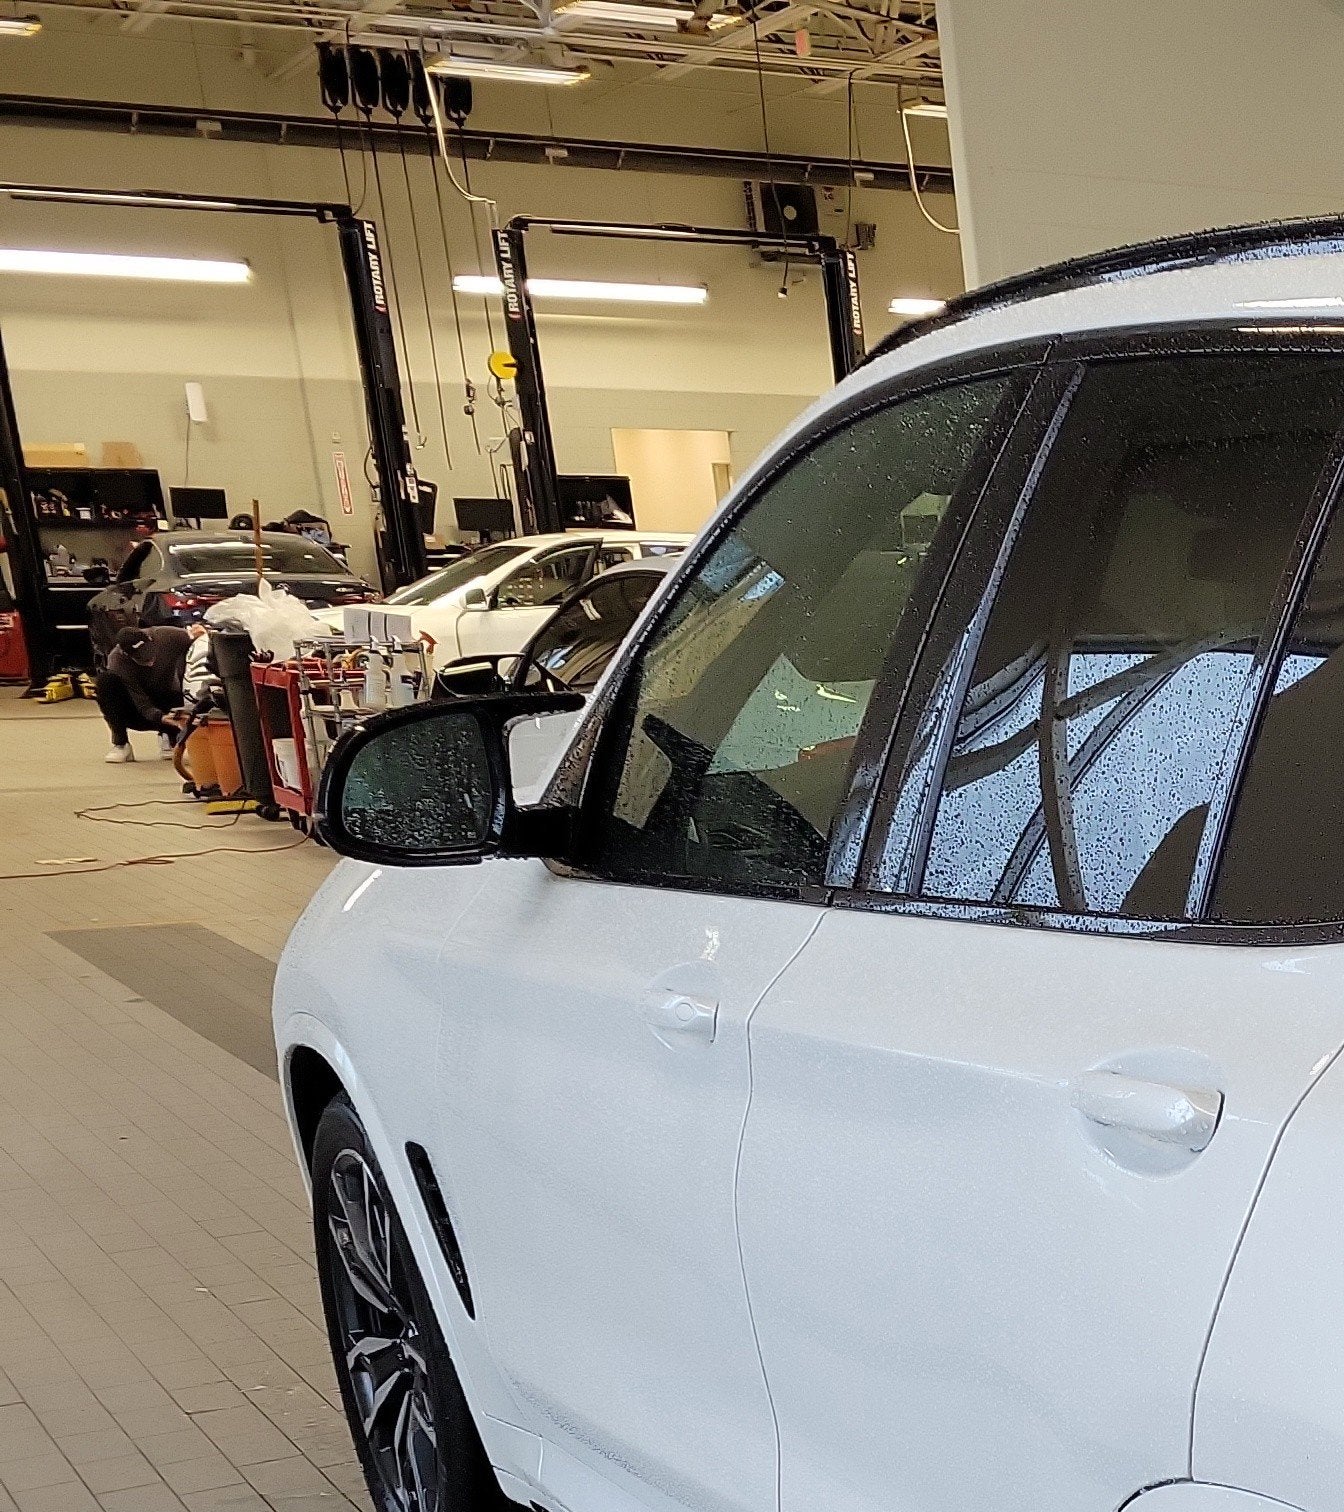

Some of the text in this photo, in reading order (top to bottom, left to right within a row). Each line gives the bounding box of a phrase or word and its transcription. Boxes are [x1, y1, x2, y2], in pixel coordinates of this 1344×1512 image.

[363, 221, 386, 305] ROTARY LIFT
[497, 229, 520, 313] ROTARY LIFT
[846, 251, 857, 279] LIFT
